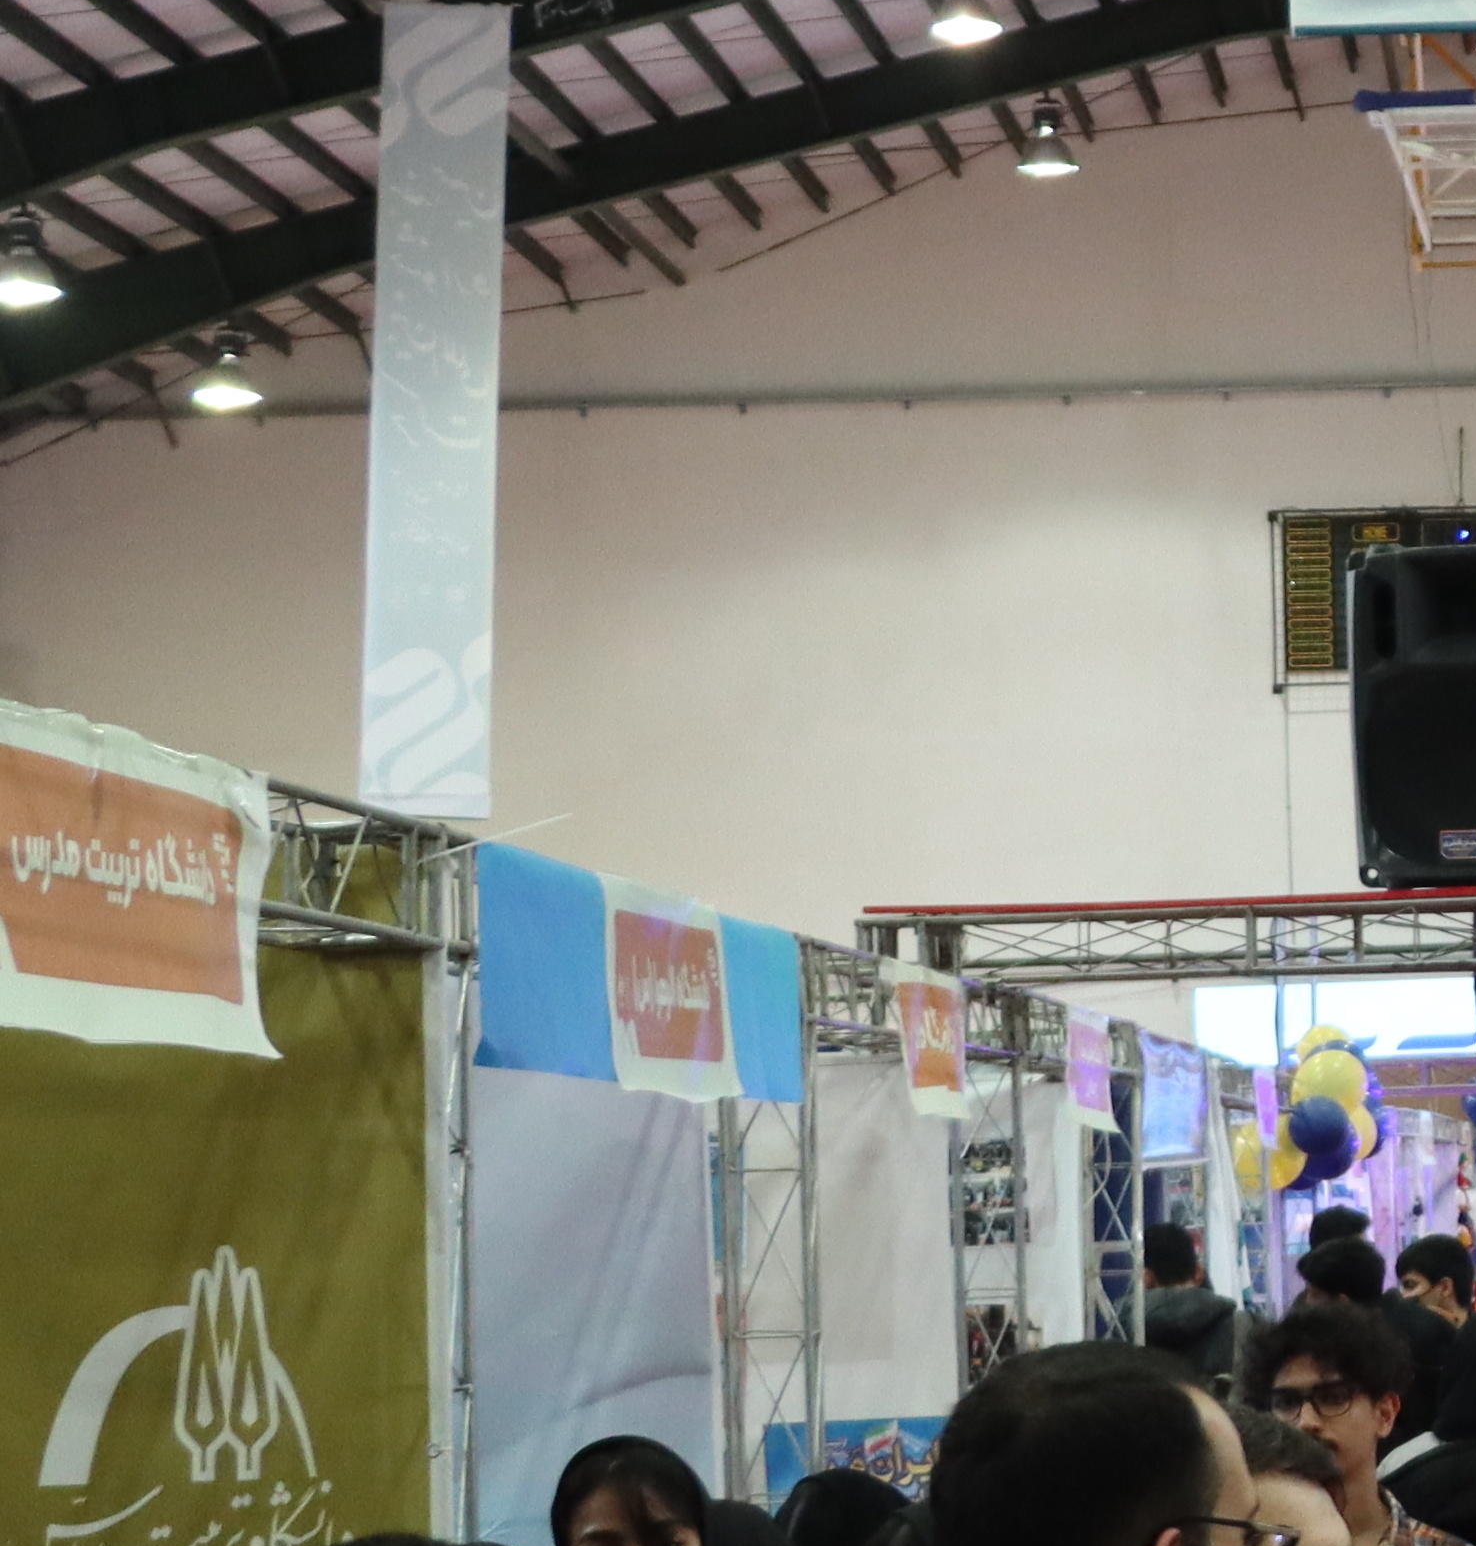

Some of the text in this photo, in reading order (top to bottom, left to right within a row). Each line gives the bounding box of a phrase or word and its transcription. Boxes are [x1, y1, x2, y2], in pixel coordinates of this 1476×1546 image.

[11, 830, 217, 909] دانشگاه تربیت مدرس
